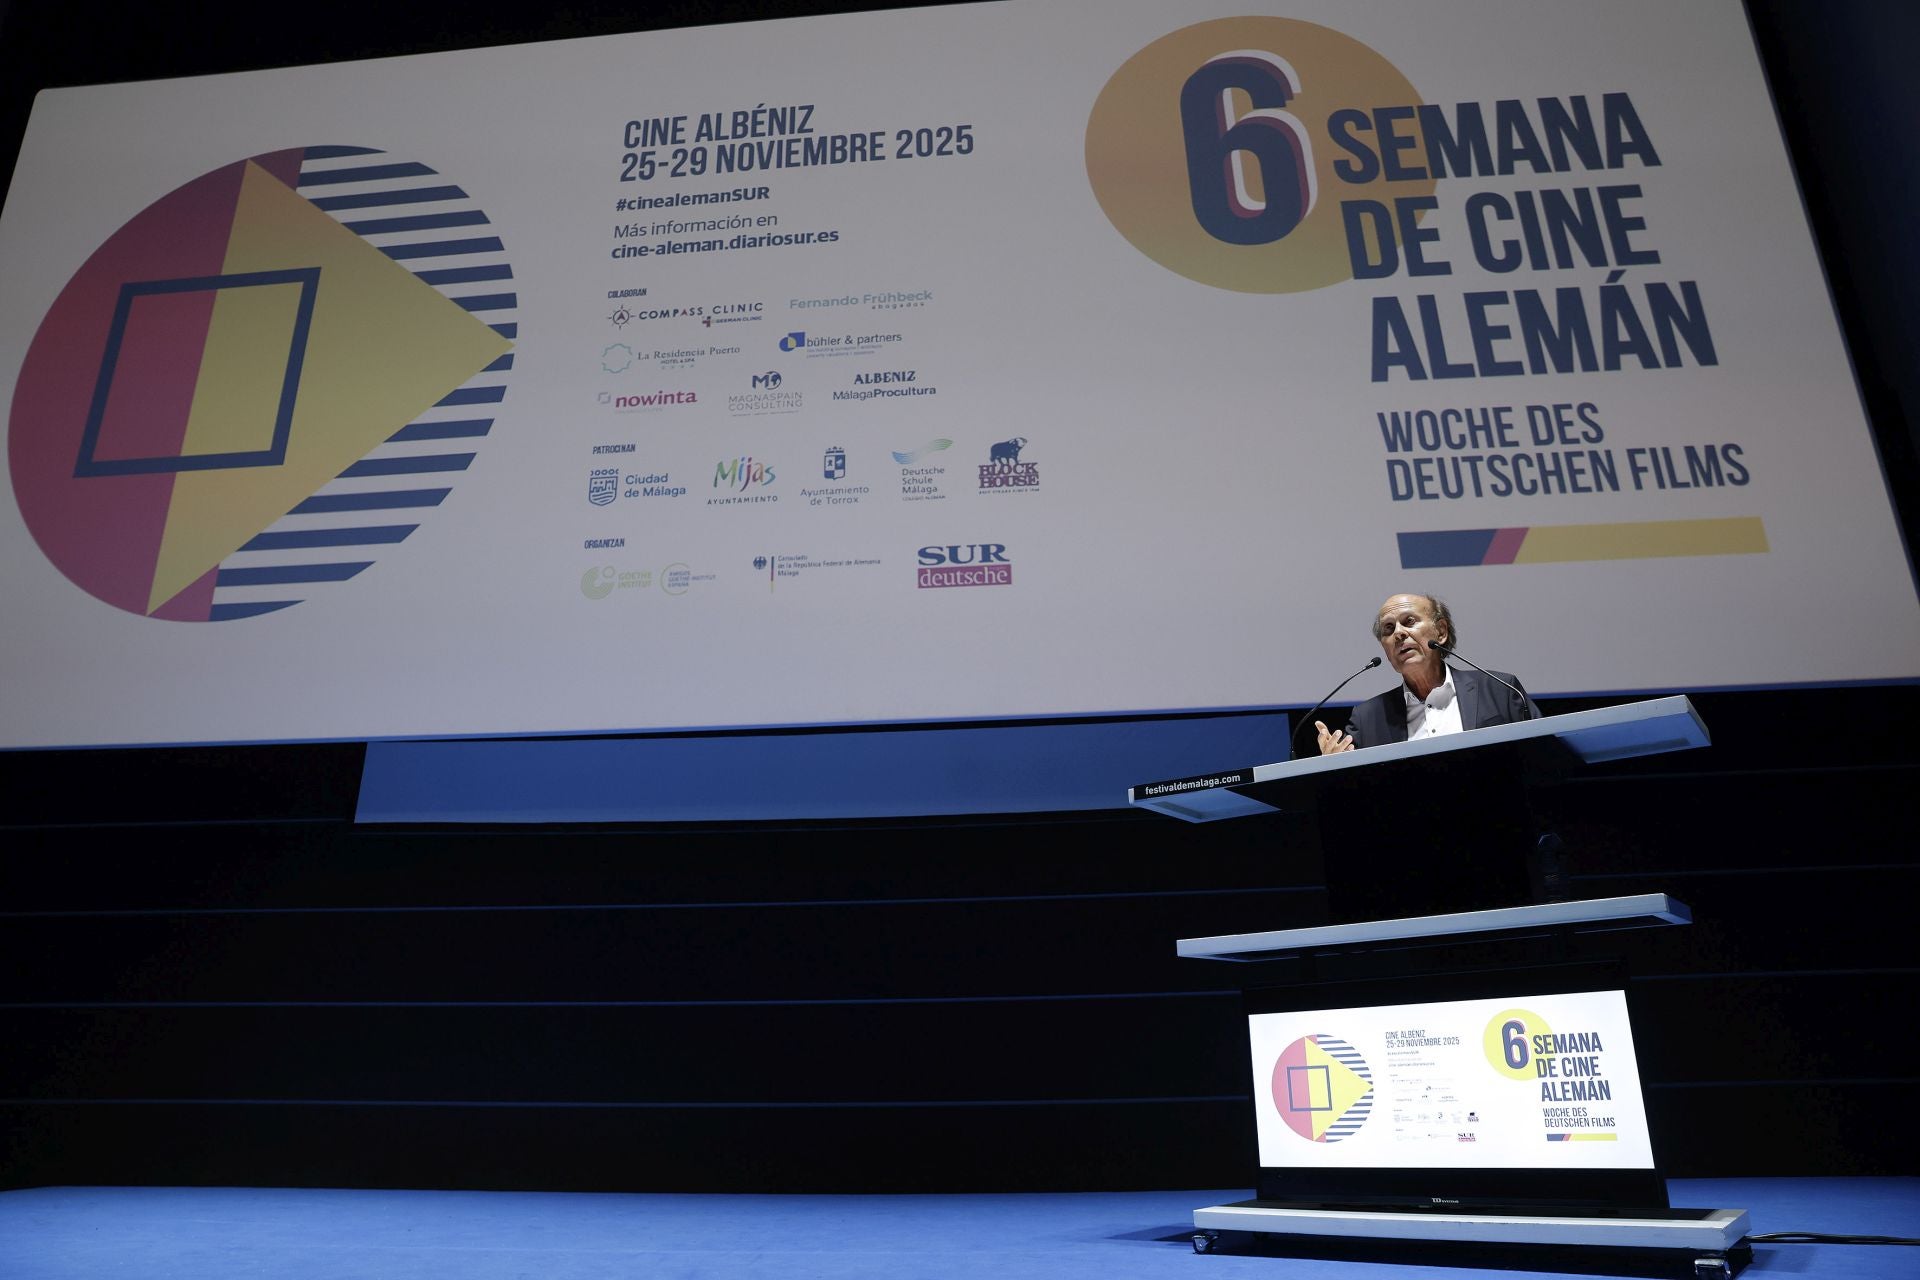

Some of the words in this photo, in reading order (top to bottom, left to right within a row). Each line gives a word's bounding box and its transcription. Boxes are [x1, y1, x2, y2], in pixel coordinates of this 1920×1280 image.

[624, 115, 687, 148] CINE
[695, 103, 814, 143] ALBÉNIZ
[1326, 91, 1662, 185] SEMANA
[620, 146, 707, 182] 25-29
[716, 131, 886, 174] NOVIEMBRE
[896, 124, 974, 159] 2025
[1180, 49, 1318, 246] 6
[616, 186, 770, 212] #cinealemanSUR
[614, 222, 647, 238] Más
[651, 214, 750, 236] información
[751, 213, 778, 228] en
[1340, 195, 1452, 280] DE
[1464, 183, 1661, 274] CINE
[611, 230, 839, 259] cine-aleman.diariosur.es
[608, 288, 647, 298] COLABORAN
[790, 295, 858, 309] Fernando
[863, 290, 933, 304] Frühbeck
[639, 306, 703, 320] COMPASS
[712, 302, 764, 315] CLINIC
[871, 302, 925, 310] abogados
[1370, 270, 1719, 382] ALEMÁN
[807, 334, 841, 347] bühler
[844, 334, 853, 345] &
[857, 333, 902, 347] partners
[637, 352, 649, 361] La
[653, 347, 705, 360] Residencia
[709, 346, 740, 356] Puerto
[854, 370, 916, 385] ALBENIZ
[615, 390, 698, 408] nowinta
[728, 391, 803, 404] MAGNASPAIN
[833, 386, 936, 401] MálagaProcultura
[728, 400, 803, 412] CONSULTING
[1377, 406, 1520, 452] WOCHE
[1526, 402, 1604, 447] DES
[592, 443, 636, 454] PATROCINAN
[713, 456, 776, 492] Mijas
[902, 466, 945, 476] Deutsche
[978, 462, 1039, 476] BLOCK
[1385, 449, 1621, 502] DEUTSCHEN
[1627, 443, 1750, 491] FILMS
[625, 473, 669, 485] Ciudad
[902, 476, 933, 484] Schule
[978, 475, 1040, 489] HOUSE
[624, 488, 639, 498] de
[642, 486, 686, 498] Málaga
[800, 486, 869, 498] Ayuntamiento
[902, 485, 938, 495] Málaga
[707, 495, 778, 505] AYUNTAMIENTO
[810, 497, 822, 506] de
[826, 495, 859, 505] Torrox
[584, 538, 625, 549] ORGANIZAN
[917, 543, 1010, 566] SUR
[920, 566, 1008, 588] deutsche
[1145, 774, 1241, 795] festivaldemalaga.com
[1406, 1037, 1441, 1047] NOVIEMBRE
[1443, 1036, 1460, 1046] 2025
[1502, 1020, 1530, 1069] 6
[1532, 1031, 1603, 1055] SEMANA
[1536, 1057, 1559, 1078] DE
[1562, 1055, 1601, 1077] CINE
[1541, 1077, 1612, 1103] ALEMÁN
[1543, 1108, 1571, 1118] WOCHE
[1572, 1107, 1588, 1117] DES
[1544, 1117, 1591, 1128] DEUTSCHEN
[1592, 1116, 1616, 1127] FILMS
